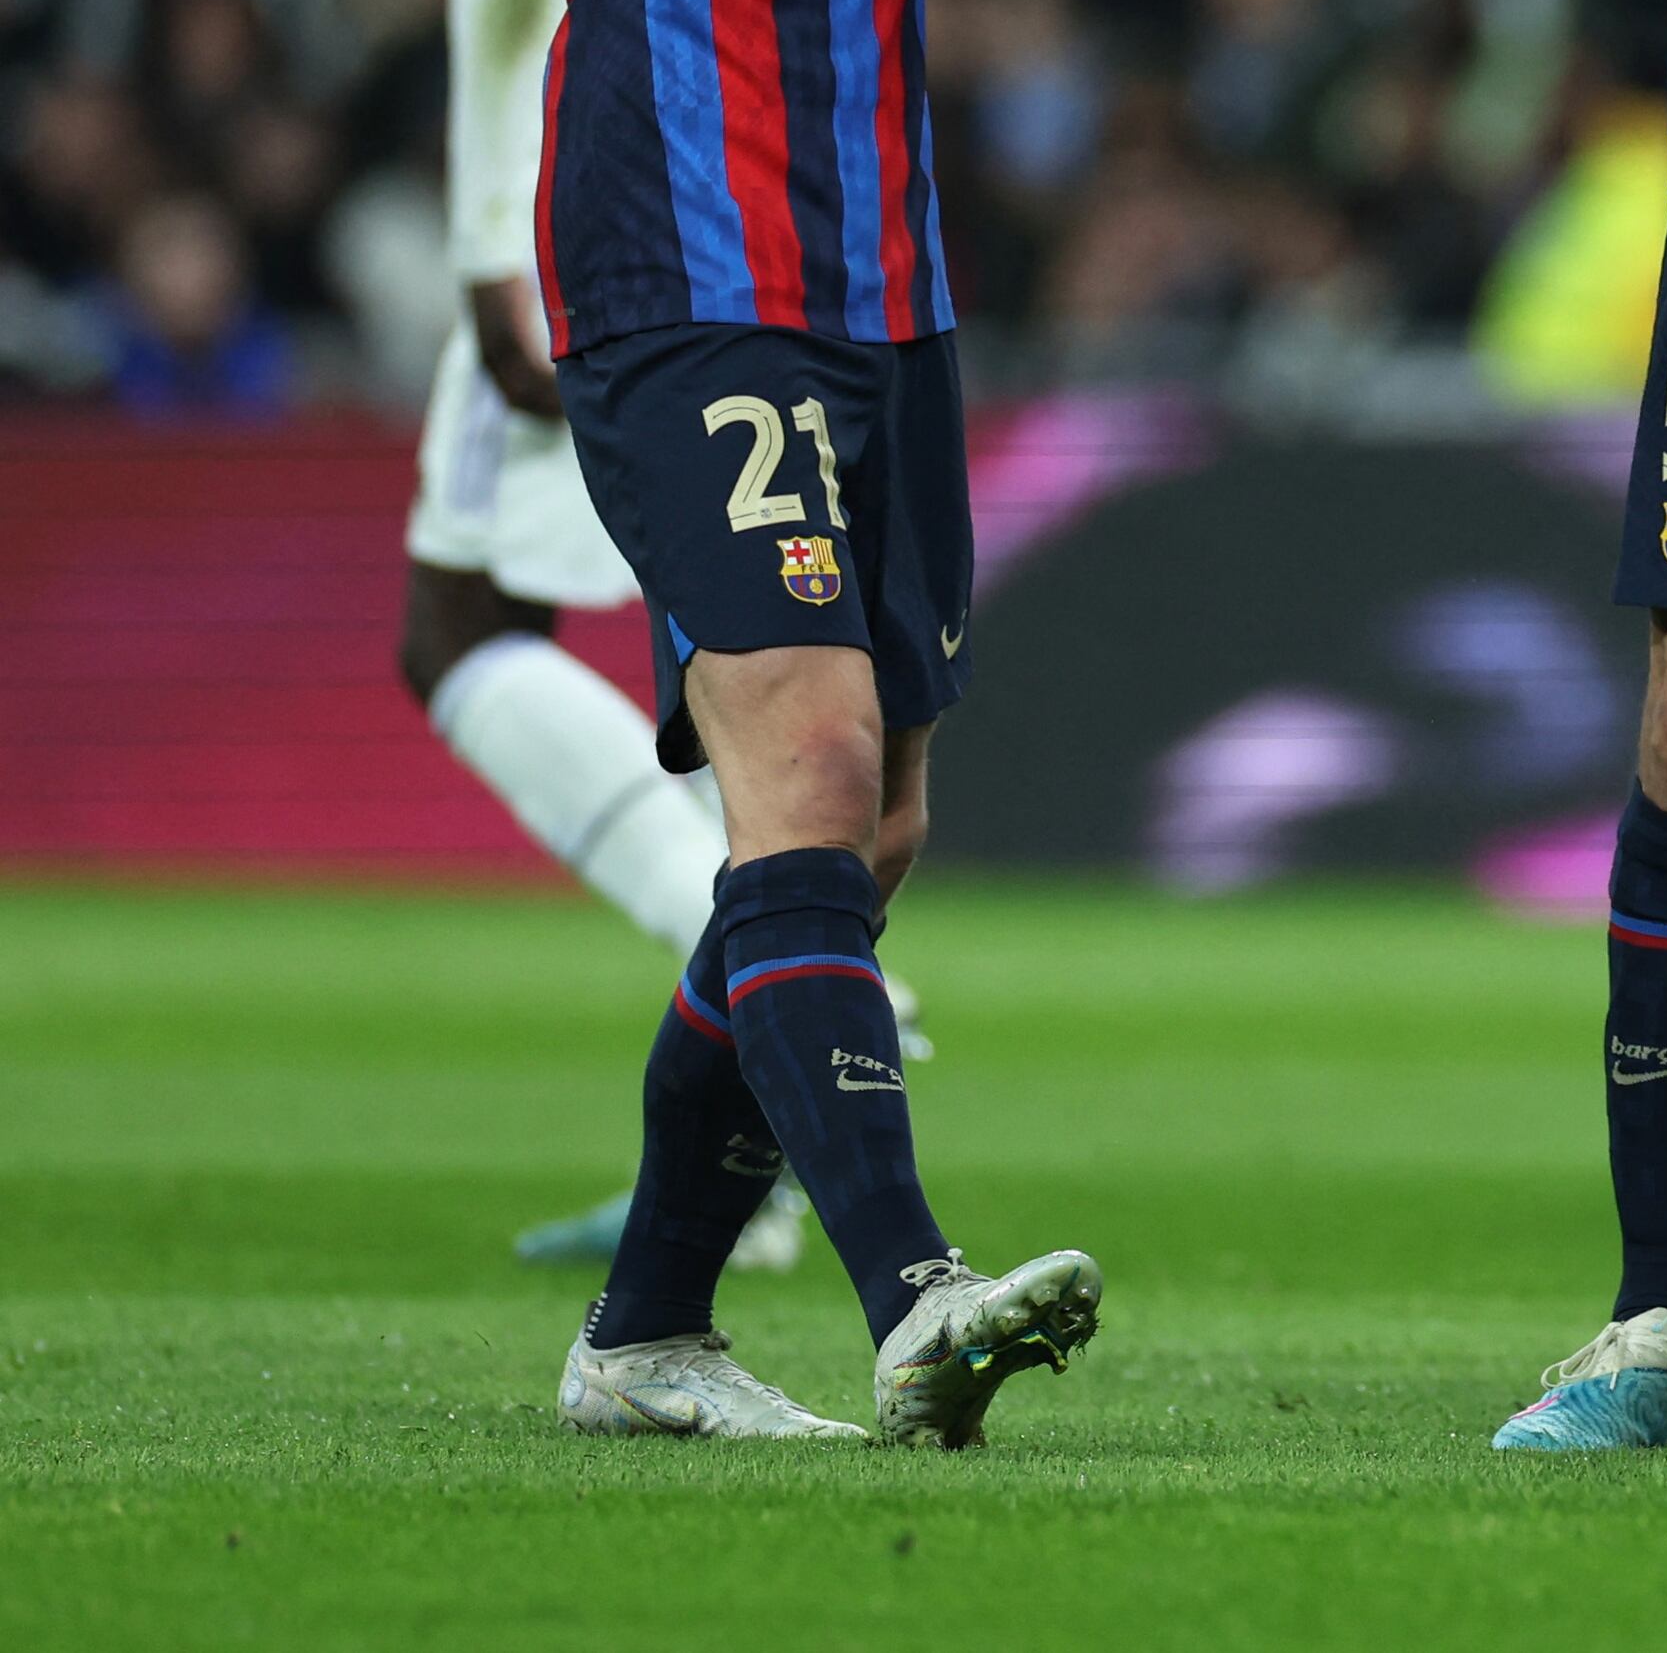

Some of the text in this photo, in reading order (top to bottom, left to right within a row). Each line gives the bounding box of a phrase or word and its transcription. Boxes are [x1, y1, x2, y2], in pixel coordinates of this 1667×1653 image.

[702, 395, 847, 533] 21
[801, 564, 825, 574] FCB
[831, 1048, 904, 1085] barç
